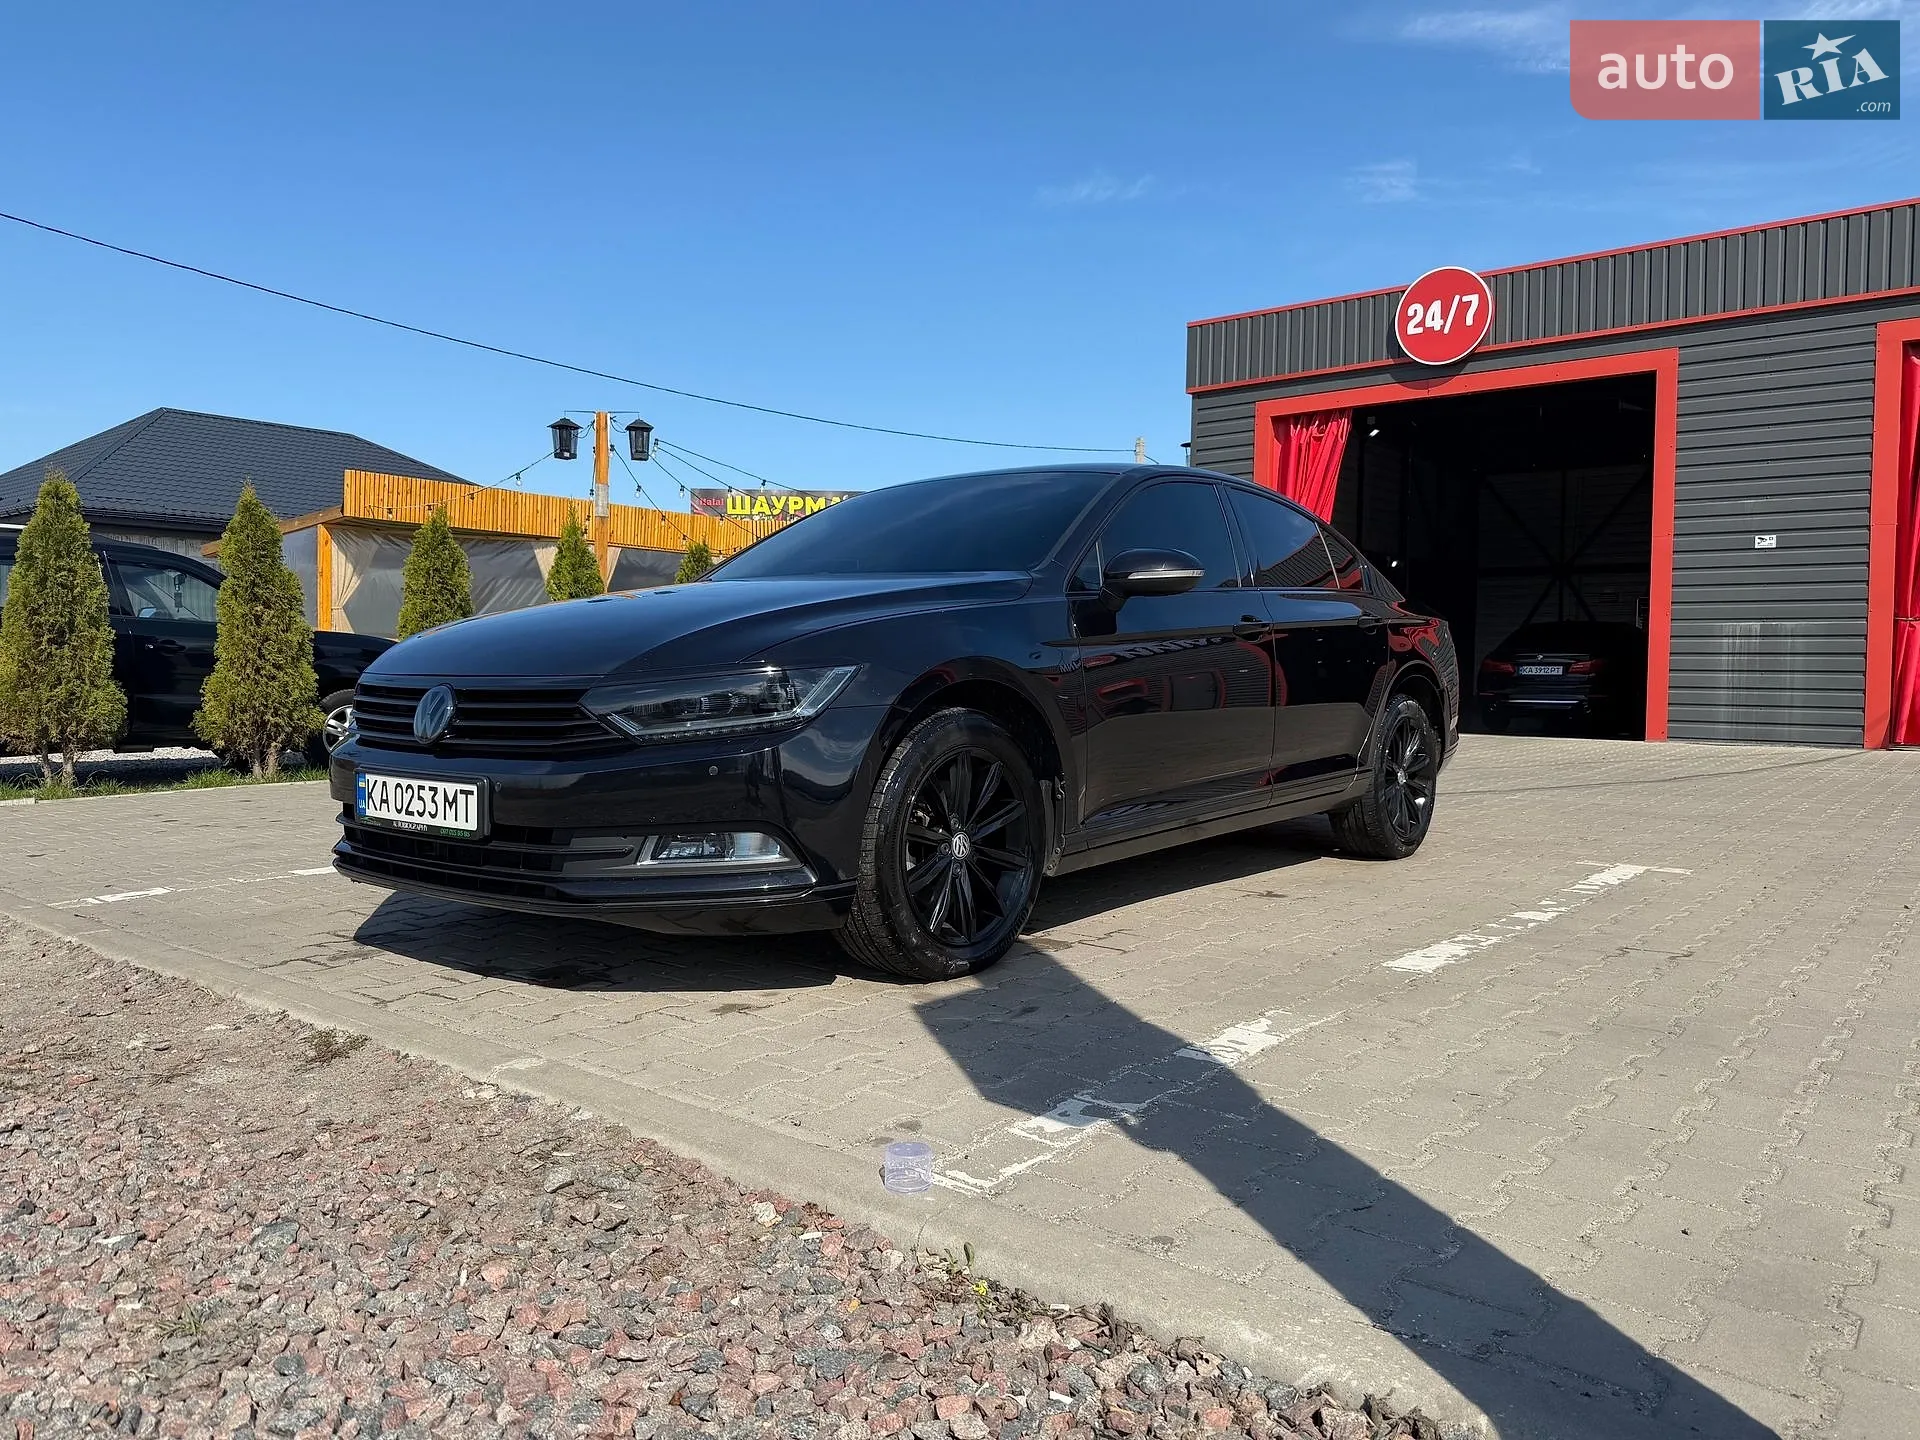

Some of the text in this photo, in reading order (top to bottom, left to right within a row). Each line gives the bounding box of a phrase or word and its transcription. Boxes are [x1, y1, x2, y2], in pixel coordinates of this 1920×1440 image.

[1406, 294, 1480, 336] 24/7
[359, 799, 366, 809] UA
[366, 778, 475, 823] KA 0253 MT
